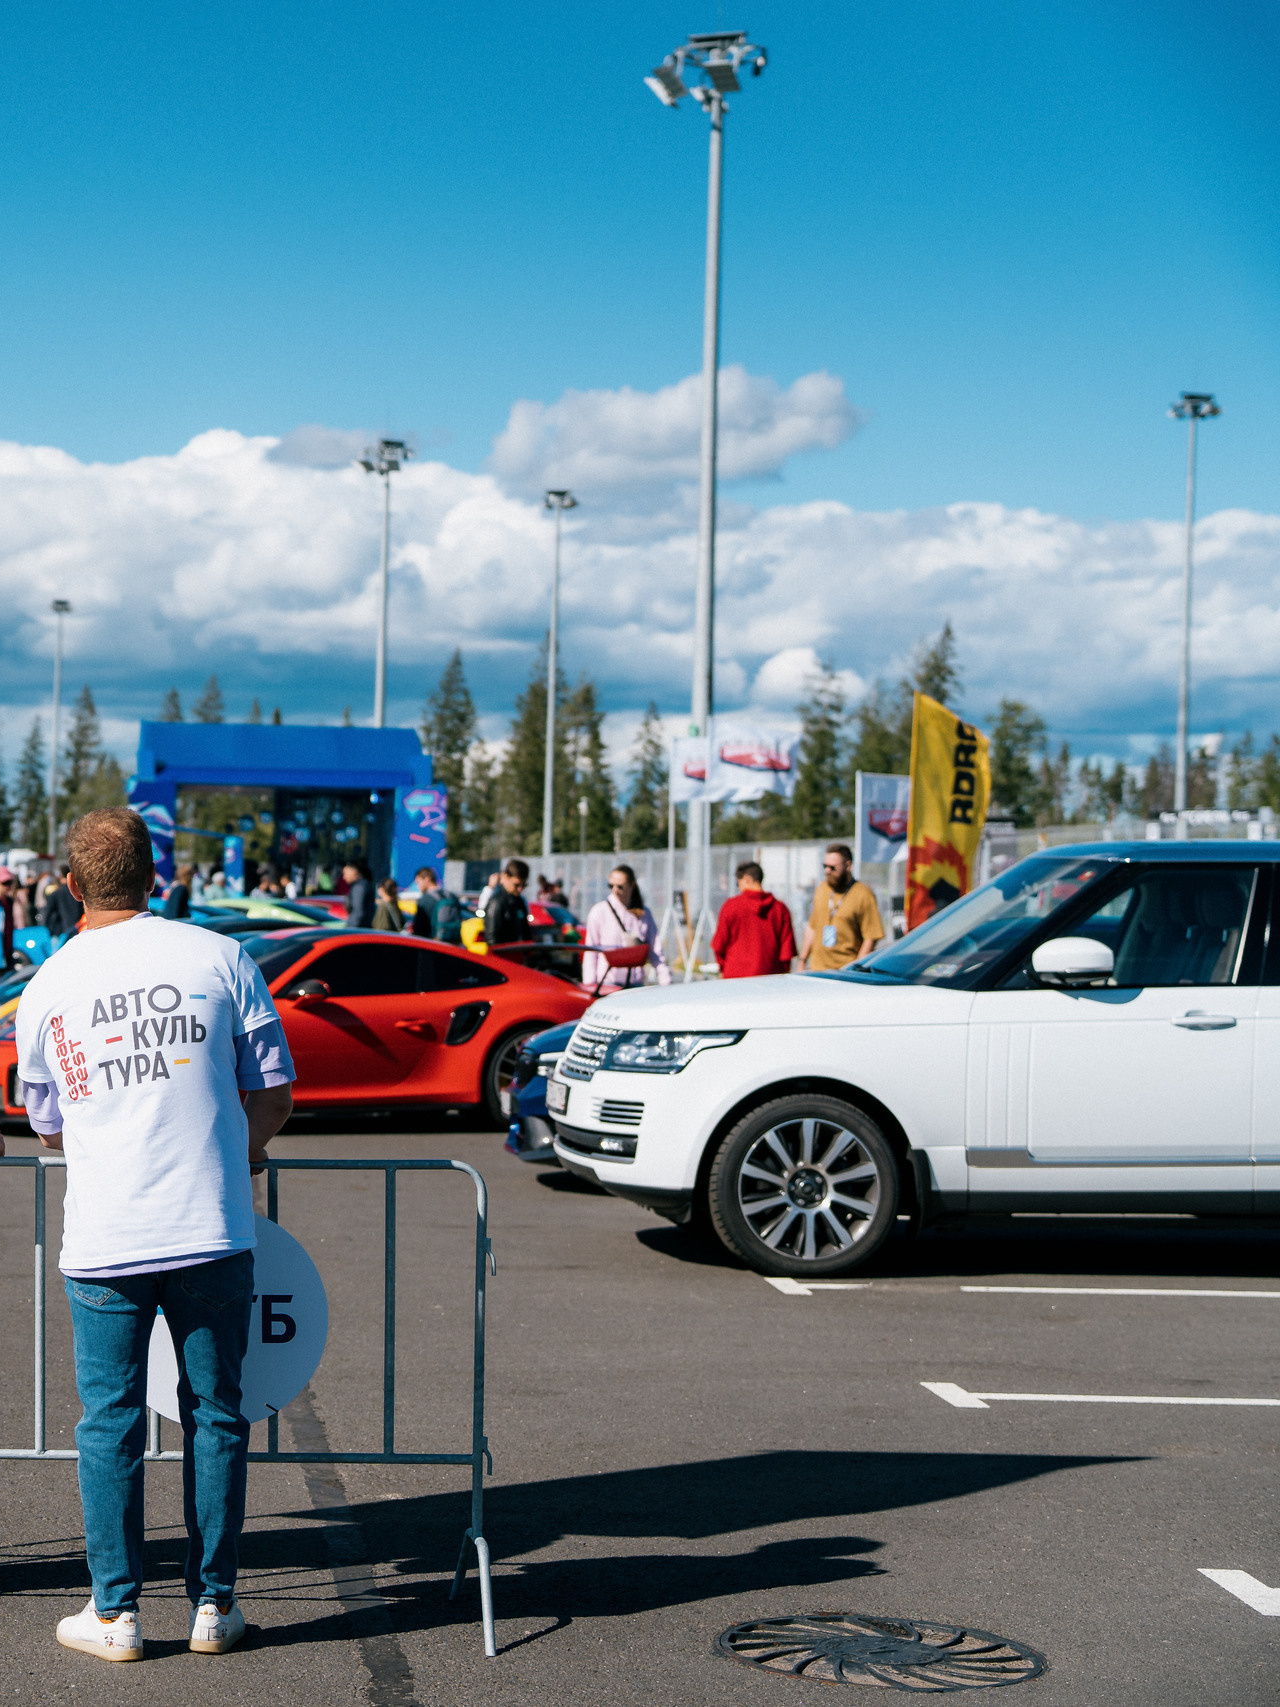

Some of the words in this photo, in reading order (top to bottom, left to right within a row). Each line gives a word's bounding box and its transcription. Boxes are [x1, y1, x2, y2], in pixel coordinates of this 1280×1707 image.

[91, 984, 182, 1028] АВТО
[132, 1015, 207, 1050] КУЛЬ
[98, 1050, 170, 1090] ТУРА
